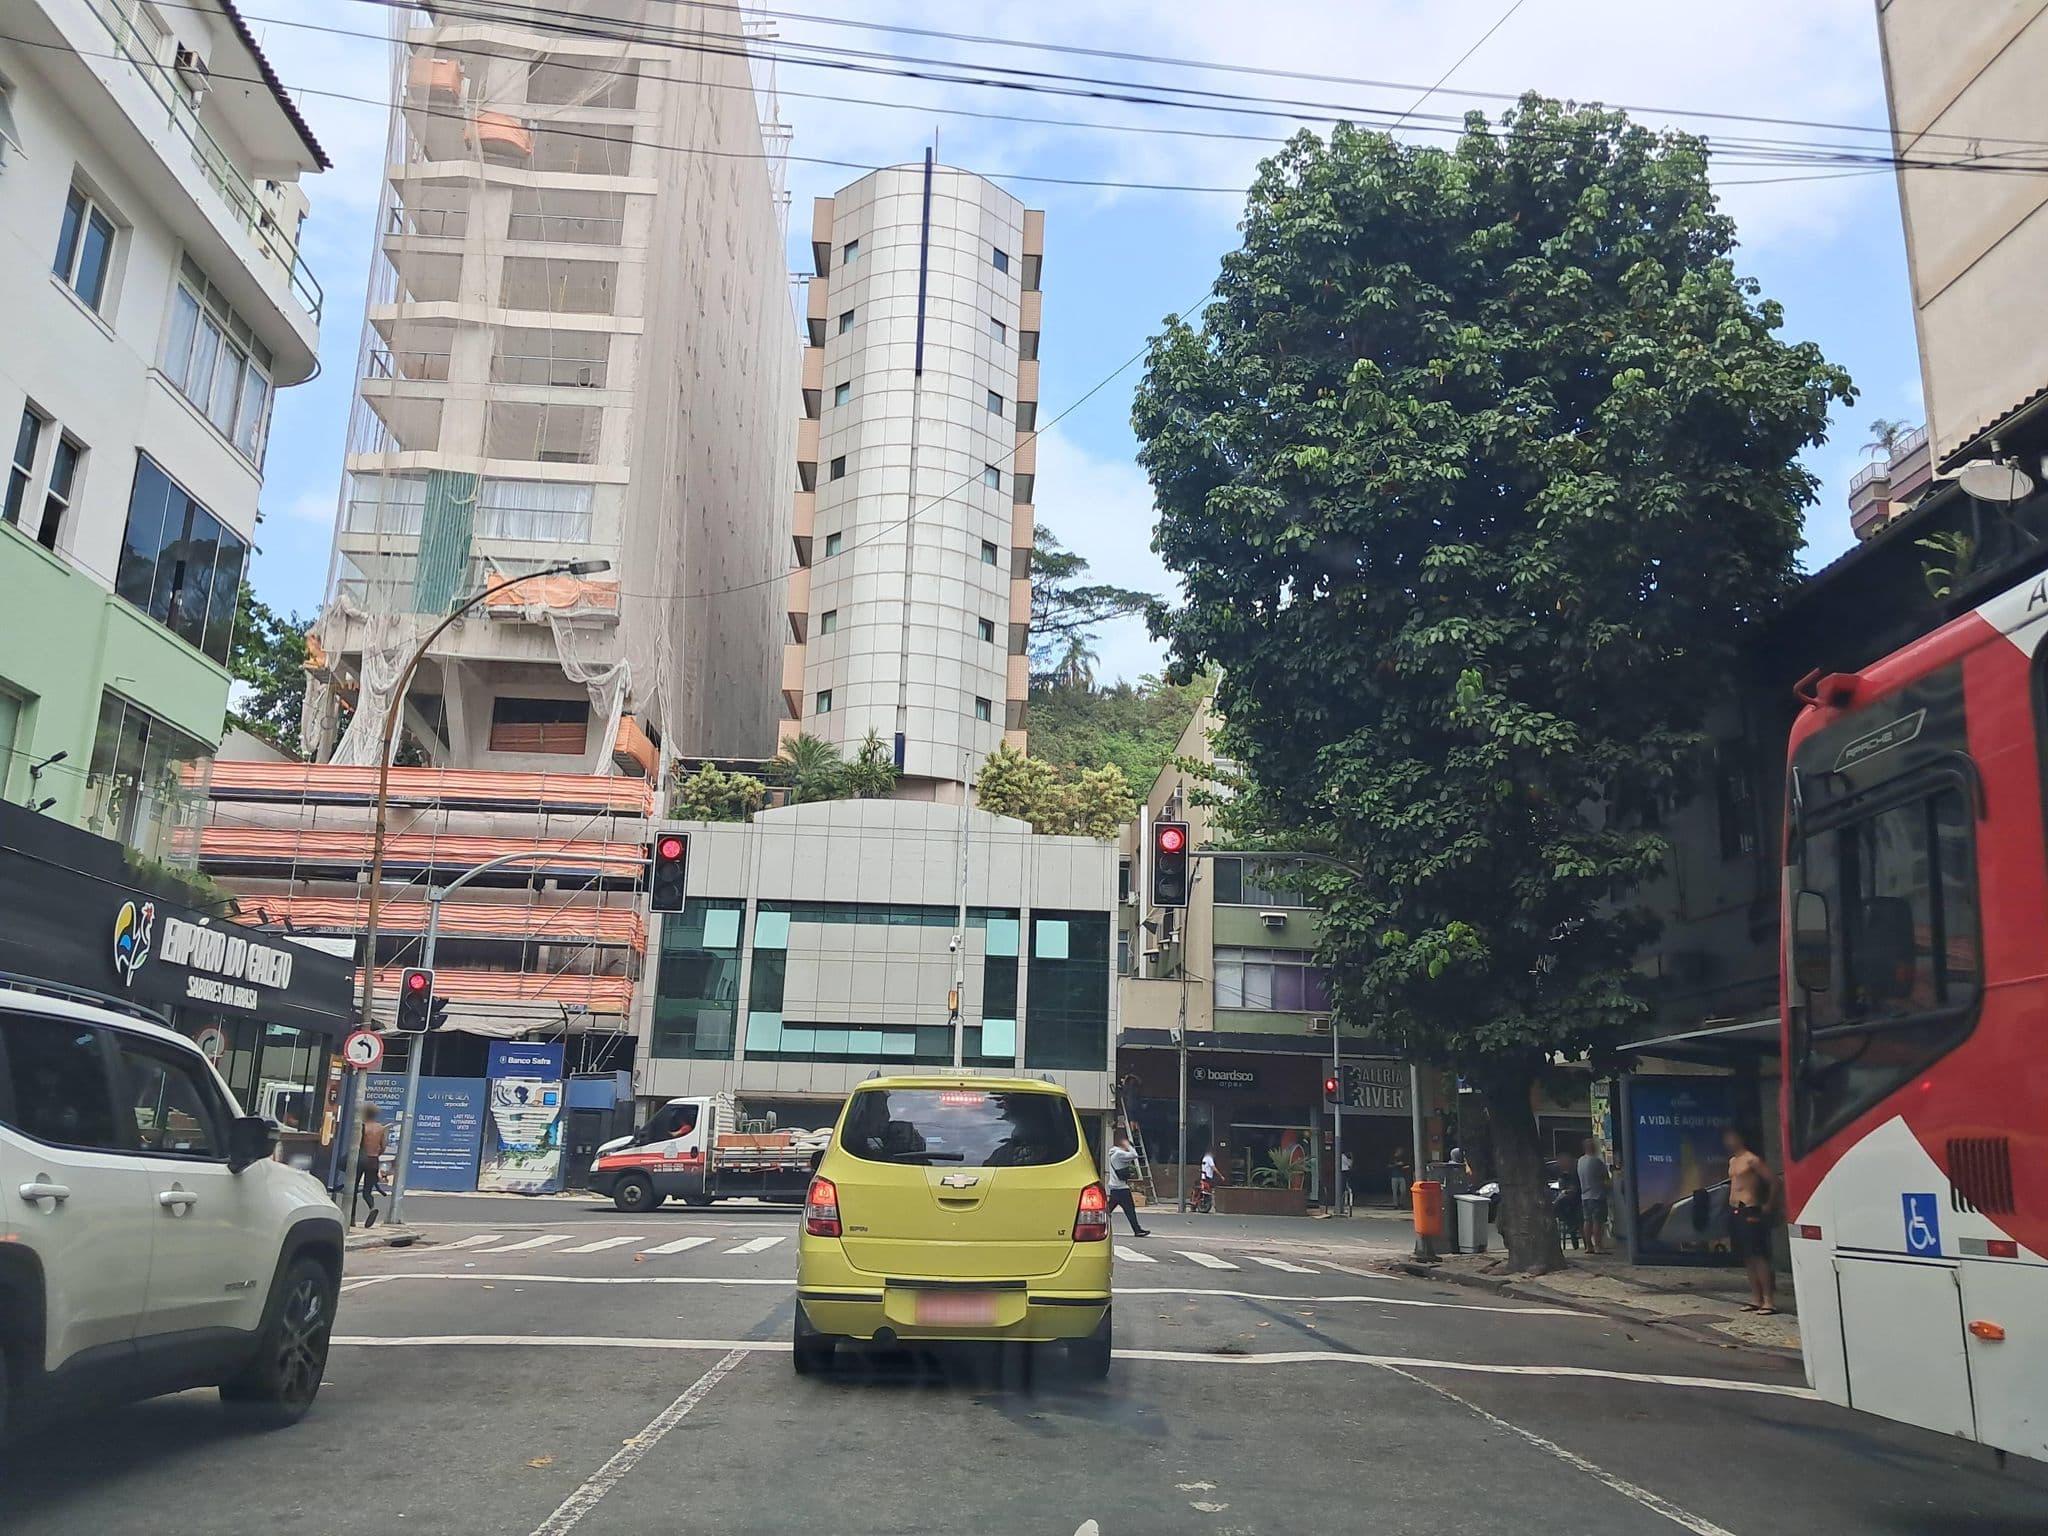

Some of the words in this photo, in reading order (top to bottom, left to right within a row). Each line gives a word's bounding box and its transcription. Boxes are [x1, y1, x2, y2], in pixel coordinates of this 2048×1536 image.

[160, 917, 227, 973] EMPÓRIO
[222, 936, 248, 979] DO
[245, 943, 293, 990] GALETO
[186, 975, 223, 1003] SABORES
[221, 983, 234, 1005] NA
[233, 986, 258, 1010] BRASA
[508, 1057, 531, 1065] Banco
[1208, 1069, 1254, 1082] boardsco
[1353, 1086, 1404, 1108] RIVER
[1640, 1115, 1647, 1125] A
[1648, 1115, 1672, 1126] VIDA
